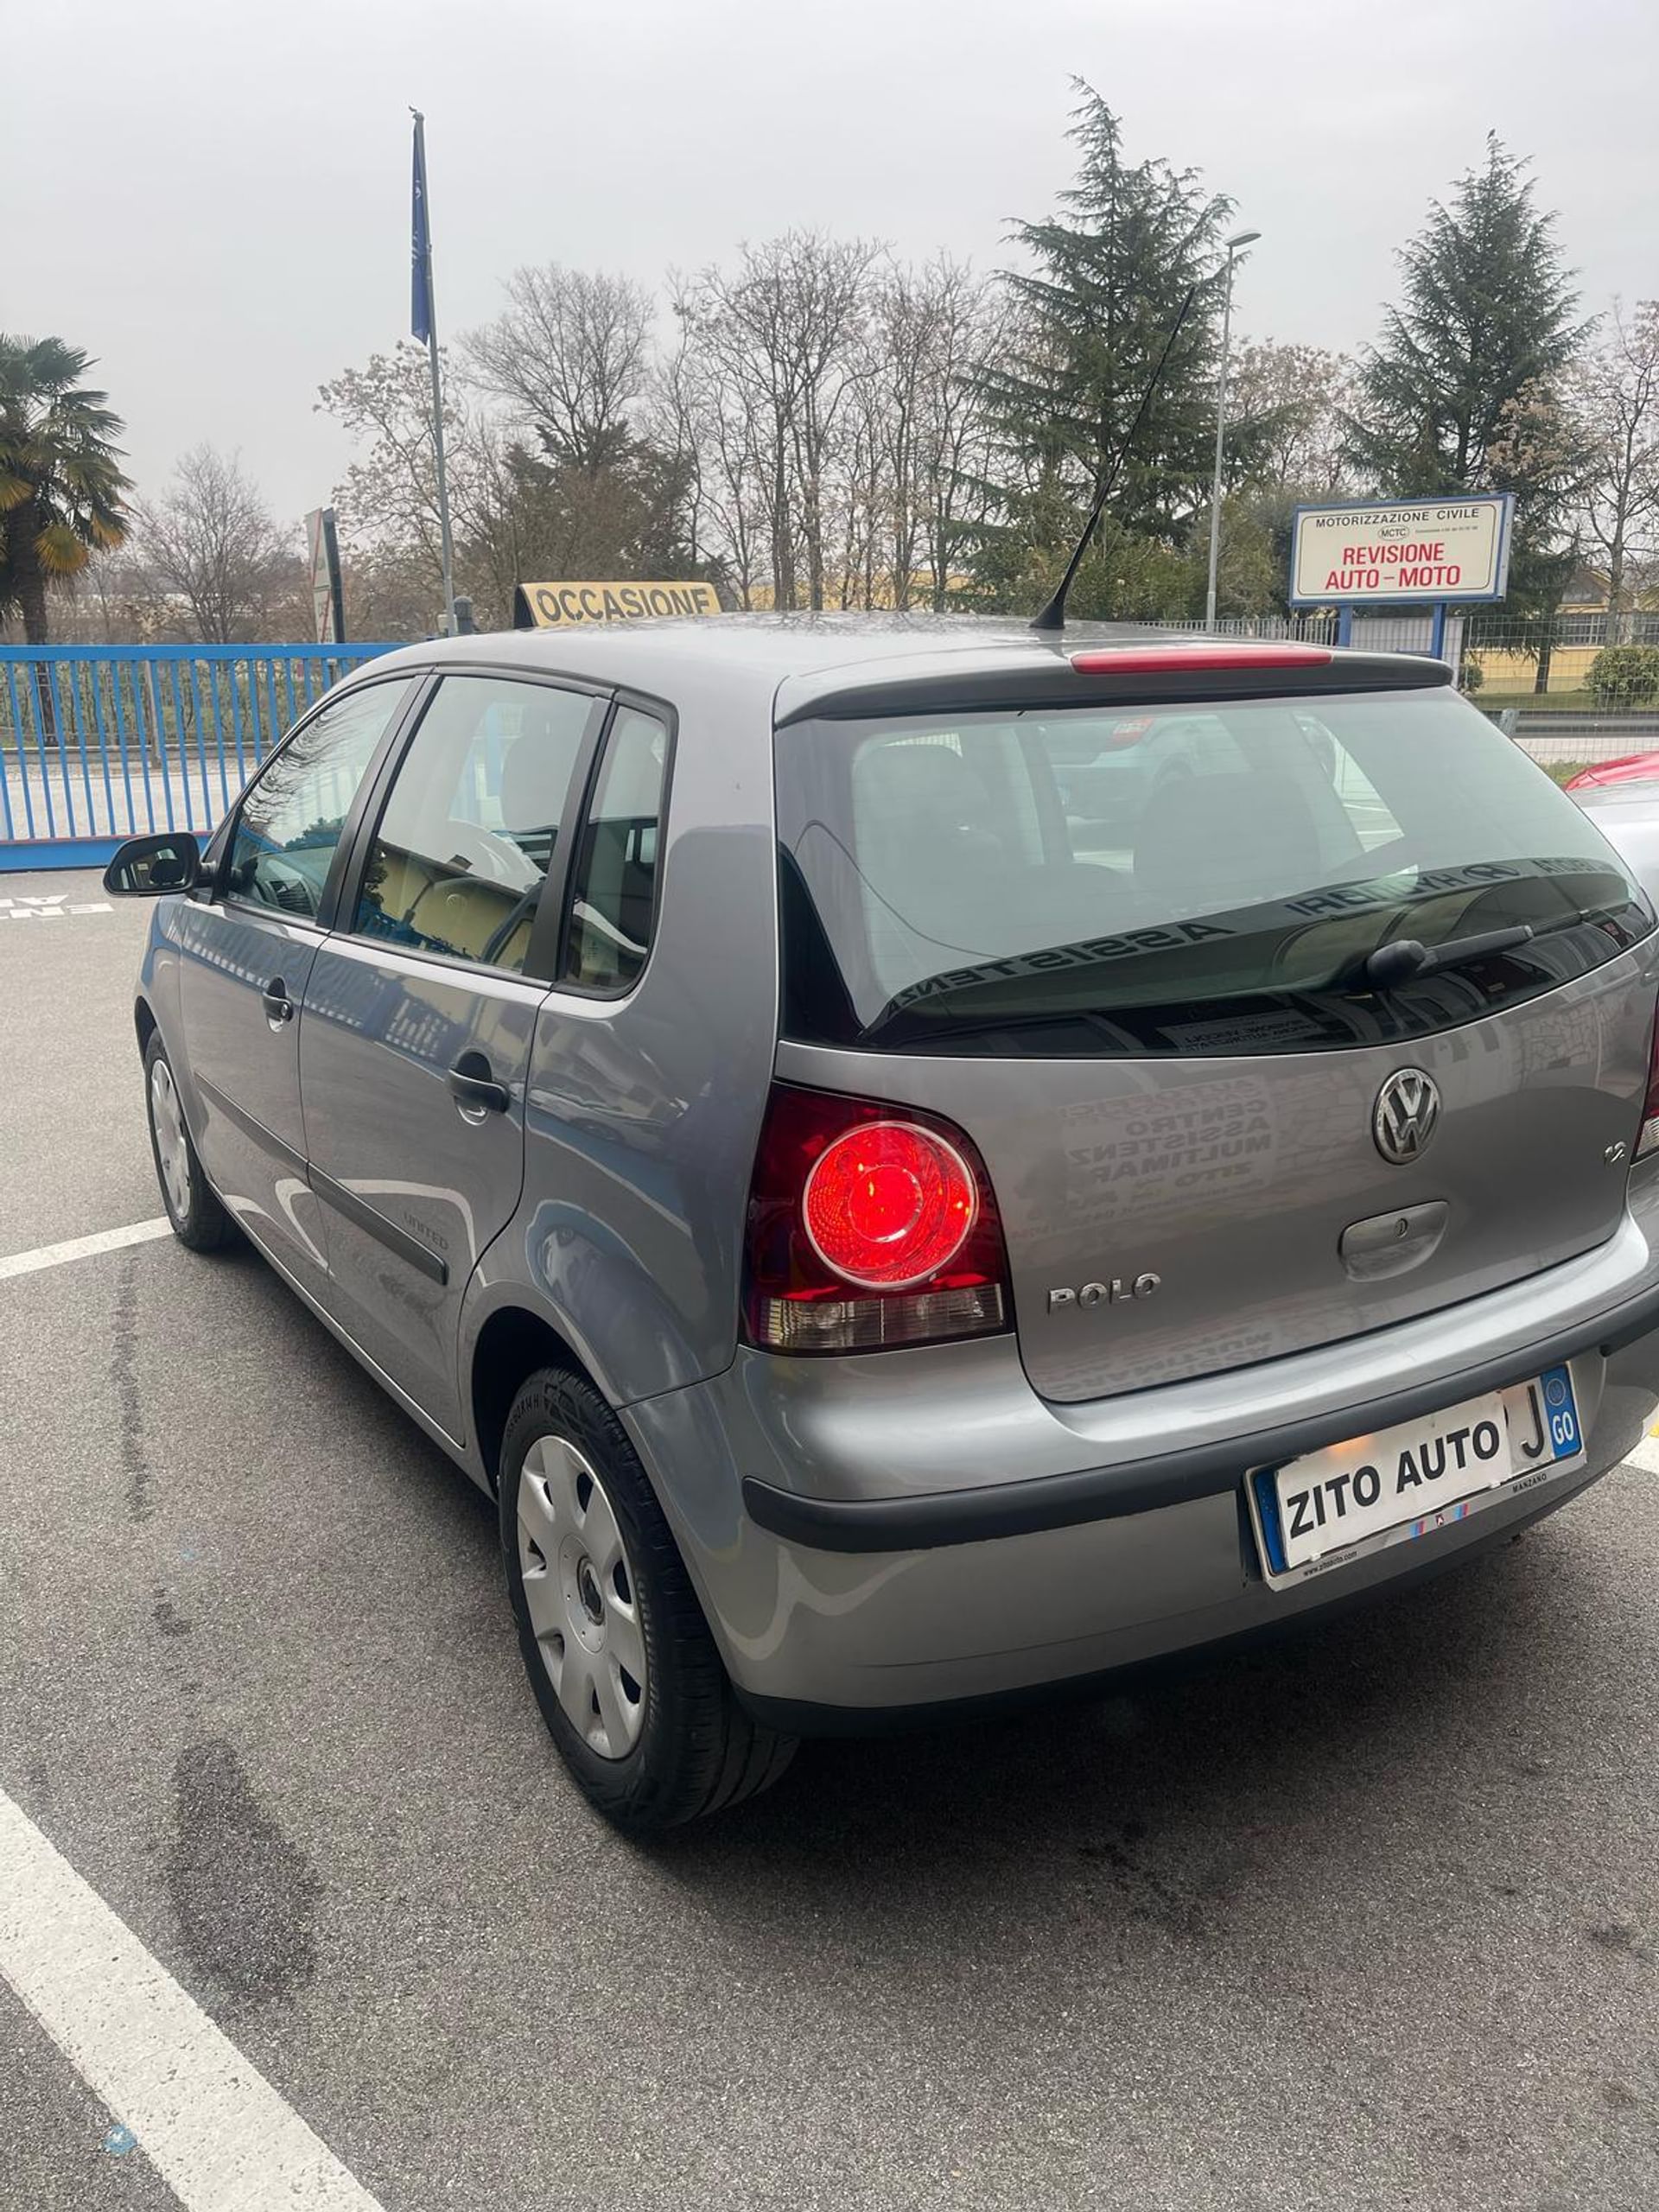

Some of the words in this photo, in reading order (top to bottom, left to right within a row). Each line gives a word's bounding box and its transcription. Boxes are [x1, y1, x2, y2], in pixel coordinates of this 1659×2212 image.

[1316, 512, 1429, 528] MOTORIZZAZIONE
[1437, 507, 1480, 520] CIVILE
[1380, 527, 1407, 538] MCTC
[1343, 543, 1445, 565] REVISIONE
[1325, 569, 1379, 589] AUTO
[1398, 565, 1461, 587] MOTO
[1047, 1272, 1161, 1315] POLO
[1552, 1411, 1574, 1446] GO
[1286, 1465, 1381, 1540] ZITO
[1395, 1421, 1500, 1494] AUTO
[1512, 1473, 1548, 1494] MANZANO
